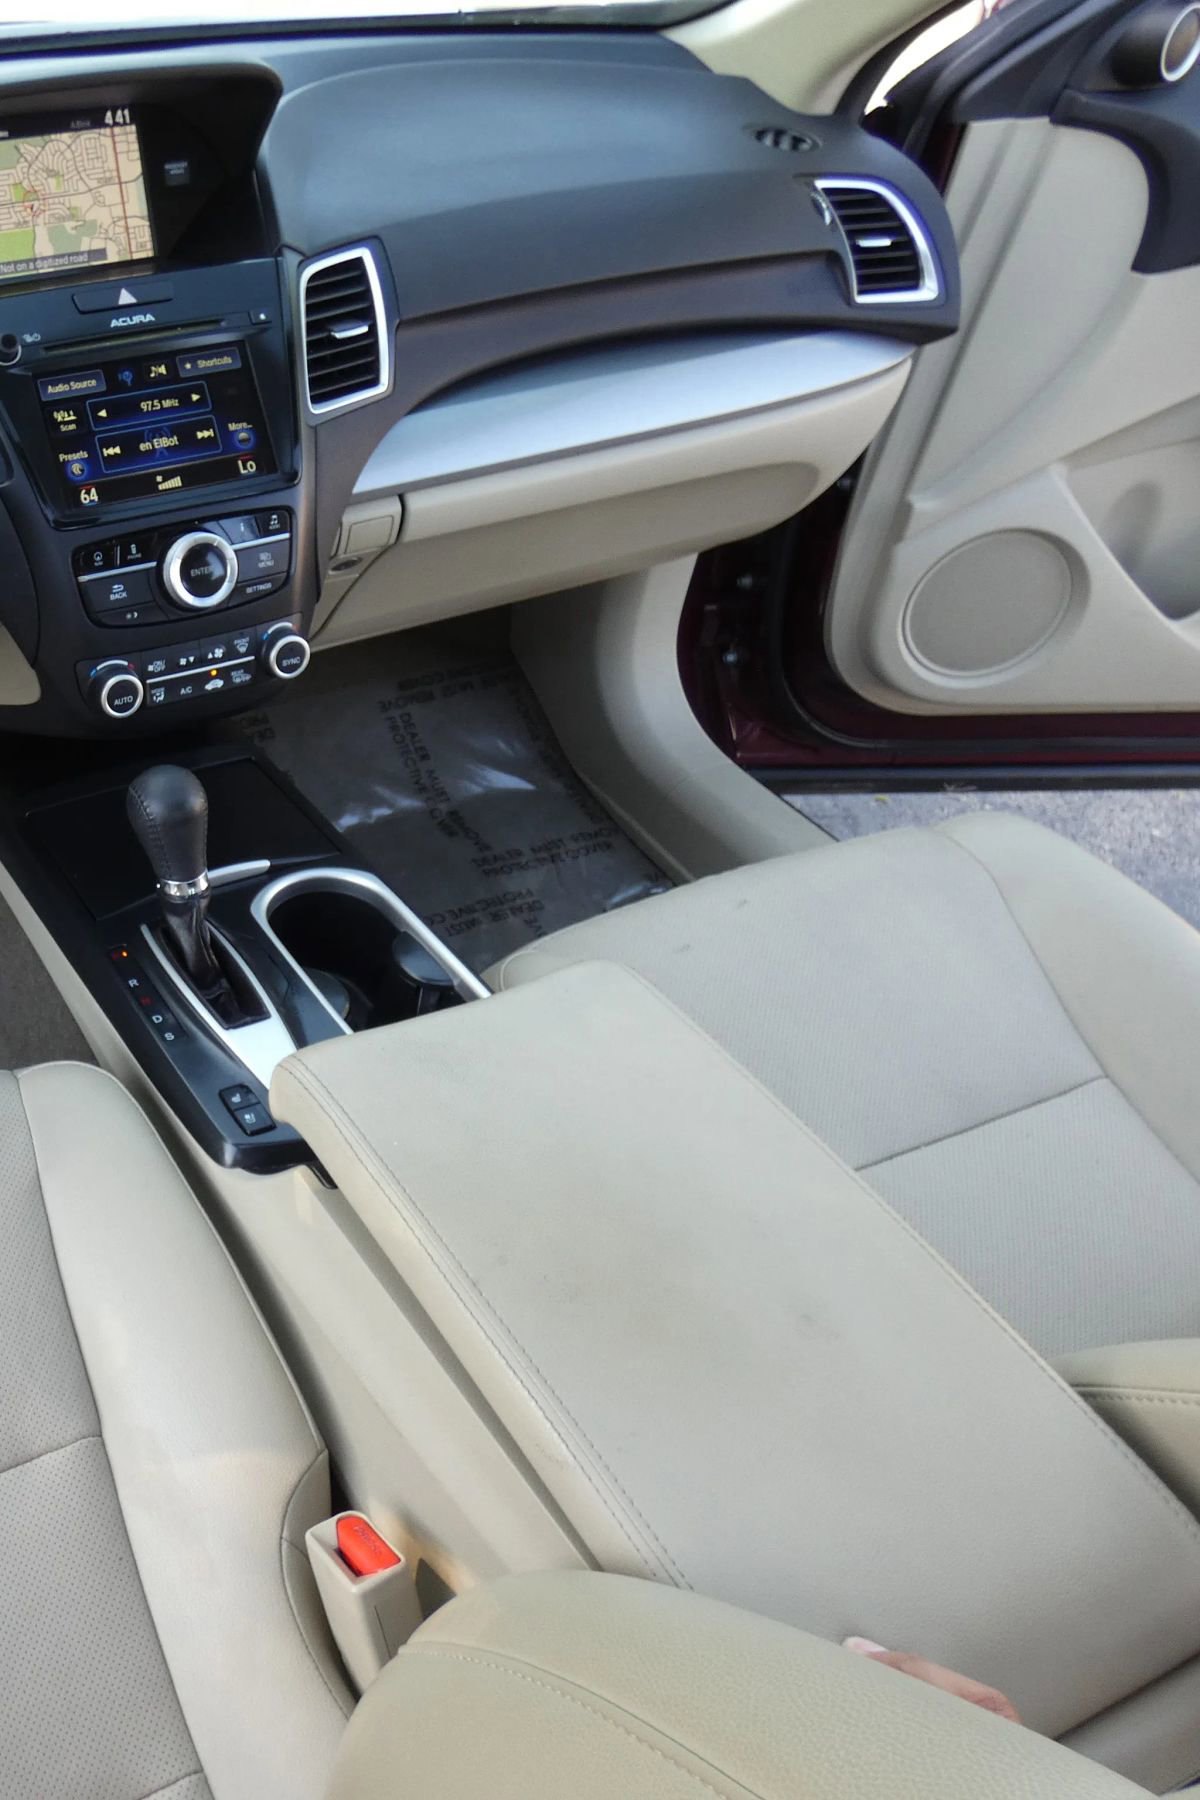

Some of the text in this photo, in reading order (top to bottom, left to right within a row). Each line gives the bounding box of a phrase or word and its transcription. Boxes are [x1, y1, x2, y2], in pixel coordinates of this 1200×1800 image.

[0, 263, 15, 273] Not
[16, 262, 27, 271] on
[35, 257, 69, 269] digitized
[70, 253, 89, 264] road
[110, 312, 156, 328] ACURA
[197, 355, 232, 369] Shortcuts
[47, 377, 97, 394] Audio Source
[140, 397, 180, 413] 97.5 MHz
[60, 422, 77, 432] Scan
[139, 442, 153, 451] en
[59, 449, 89, 463] Presets
[237, 458, 257, 475] Lo
[80, 487, 99, 505] 64
[246, 582, 273, 594] SETTINGS
[110, 591, 128, 600] BACK
[281, 655, 302, 667] SYNC
[113, 695, 134, 706] AUTO
[399, 712, 431, 762] DEALER
[386, 715, 429, 795] PROTECTIVE
[128, 978, 139, 988] R
[151, 1014, 163, 1024] D
[164, 1031, 175, 1041] S
